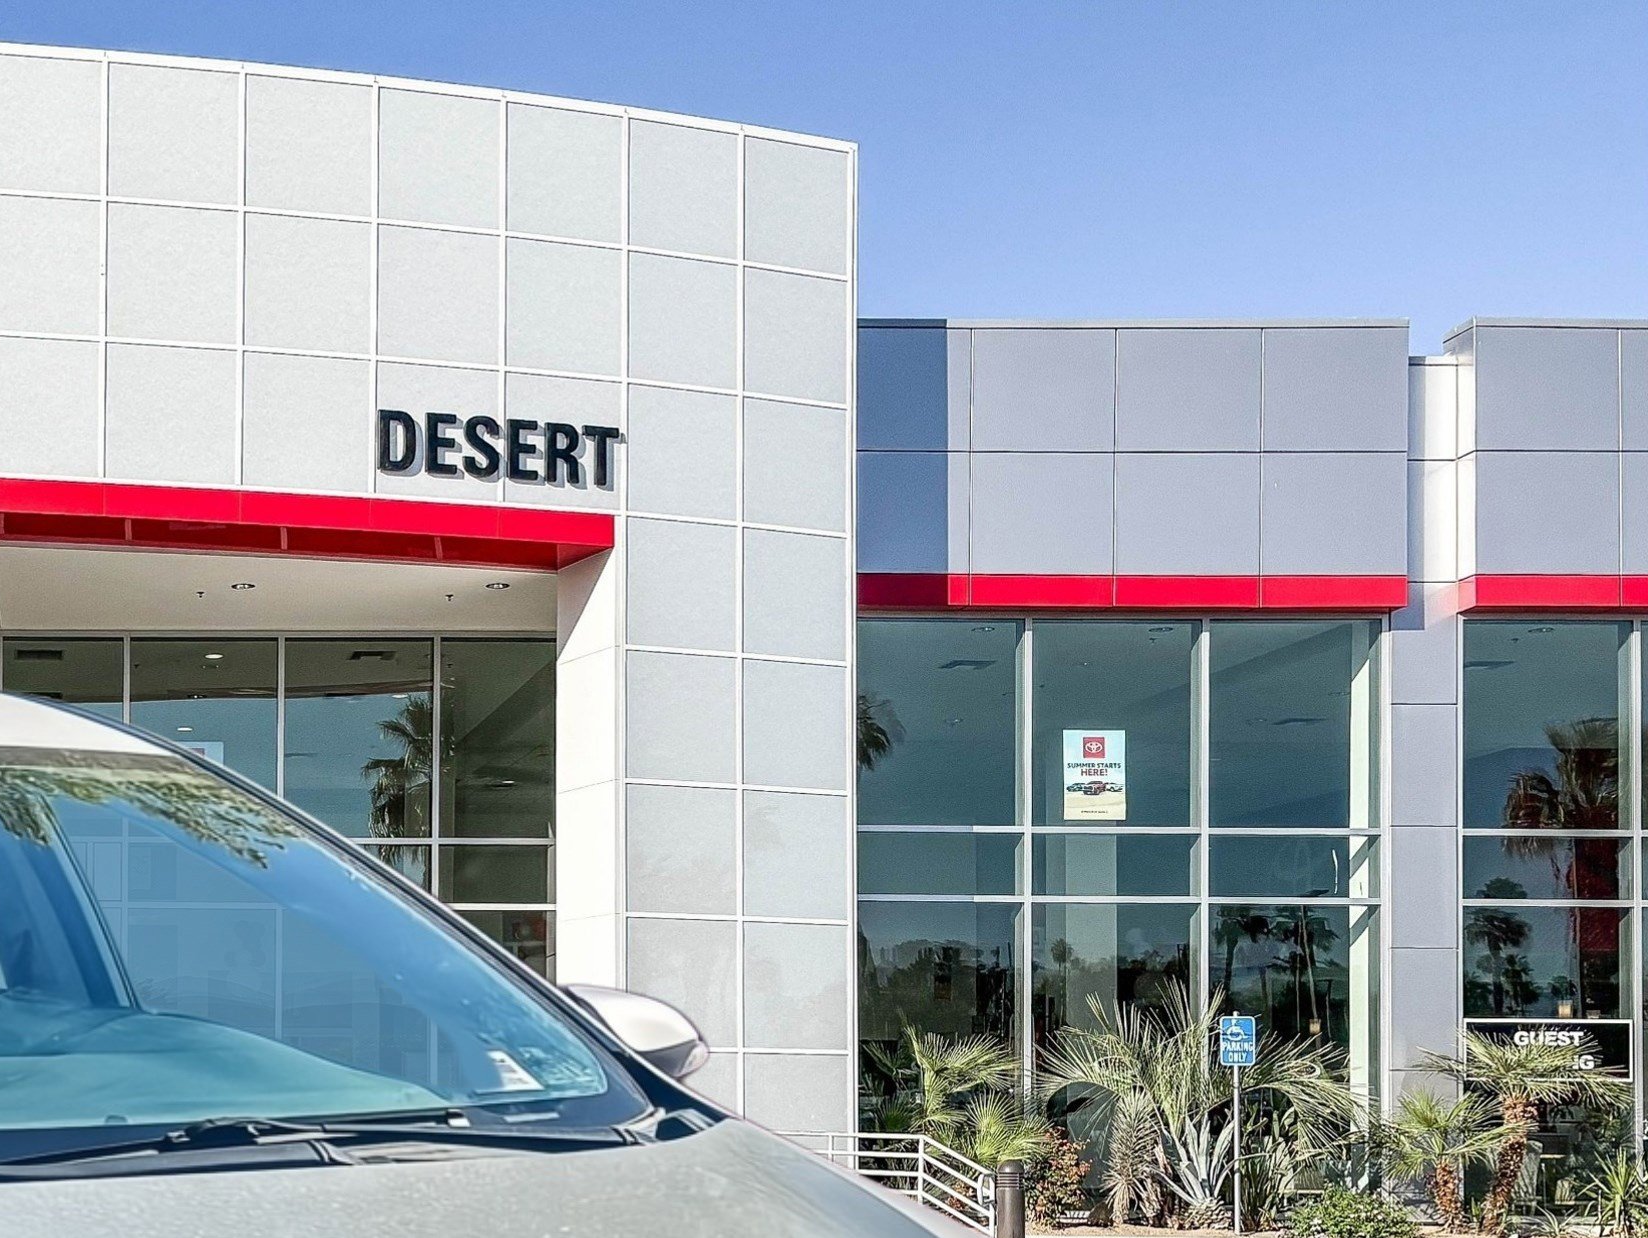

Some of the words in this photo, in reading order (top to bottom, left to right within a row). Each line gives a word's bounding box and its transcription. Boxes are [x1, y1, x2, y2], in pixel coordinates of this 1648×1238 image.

[377, 409, 620, 487] DESERT
[1080, 768, 1108, 777] HERE!
[1513, 1031, 1584, 1047] GUEST
[1222, 1041, 1254, 1052] PARKING
[1228, 1051, 1248, 1062] ONLY
